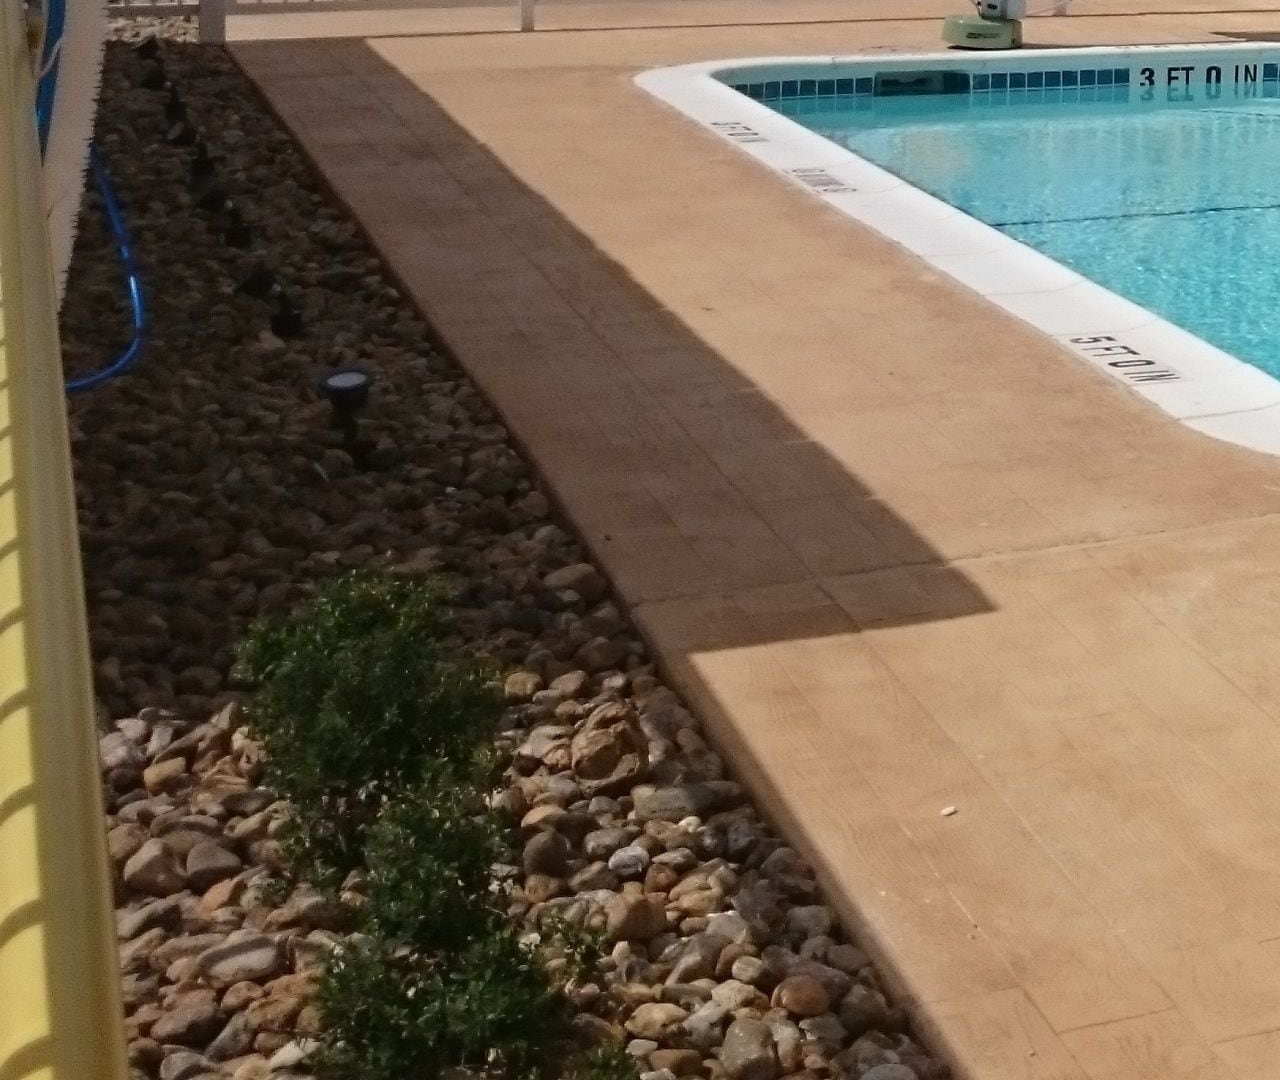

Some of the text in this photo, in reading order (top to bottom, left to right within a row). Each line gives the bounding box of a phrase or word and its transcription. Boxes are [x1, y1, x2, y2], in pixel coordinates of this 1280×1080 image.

[1140, 67, 1155, 87] 3
[1167, 66, 1195, 86] FT
[1234, 63, 1258, 84] IN
[1069, 335, 1181, 382] 5 FT 0 IN
